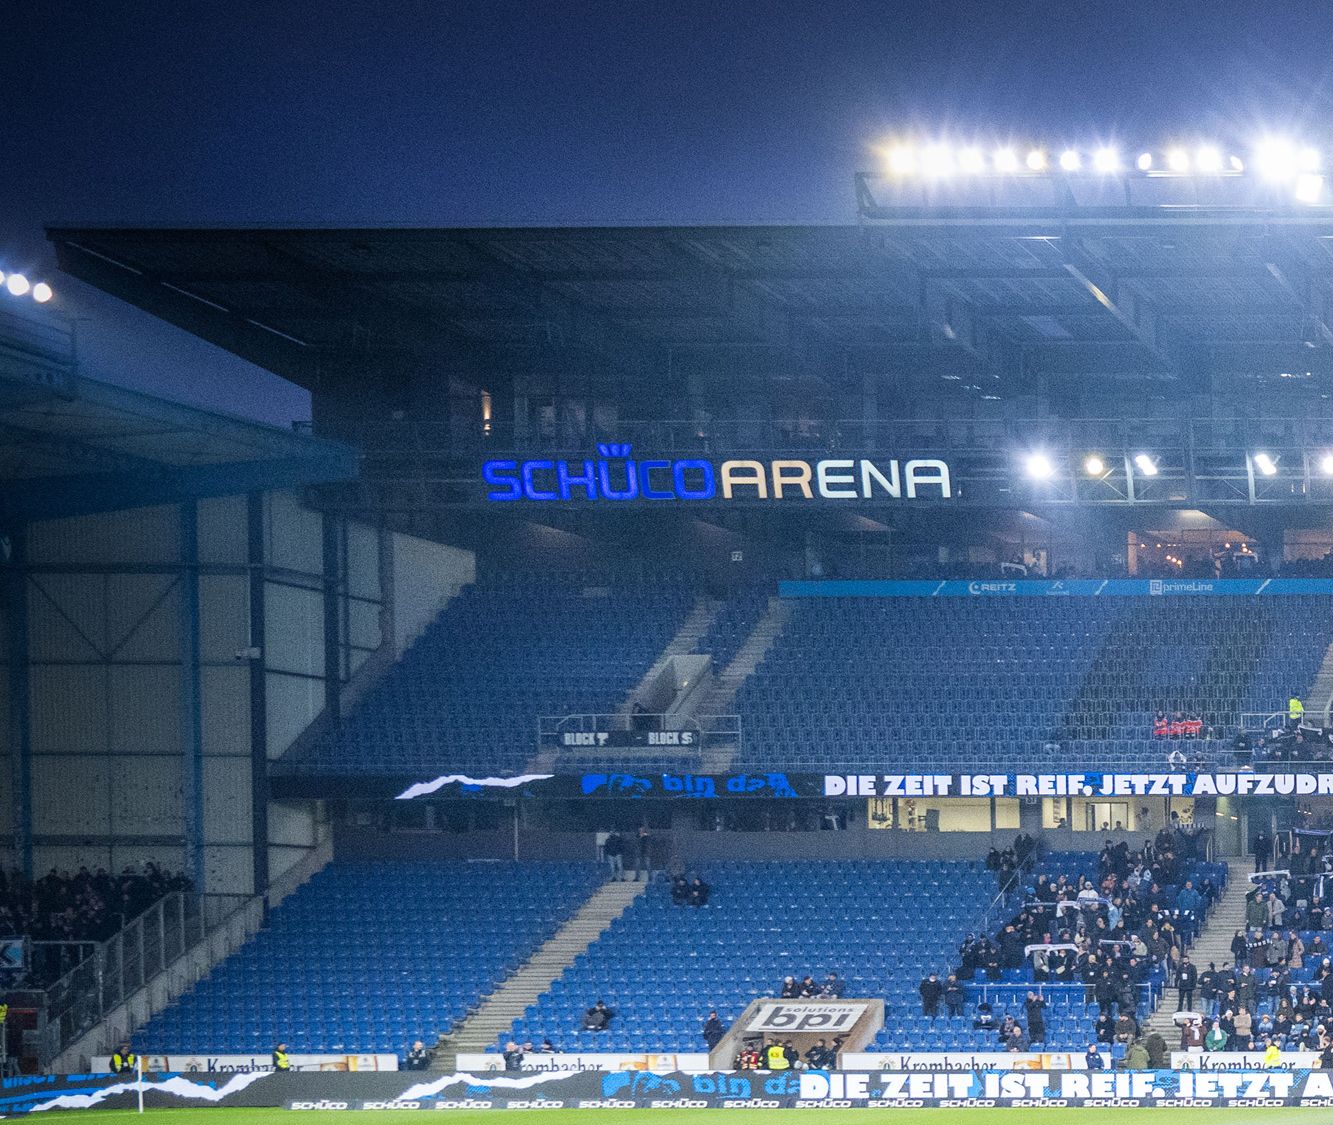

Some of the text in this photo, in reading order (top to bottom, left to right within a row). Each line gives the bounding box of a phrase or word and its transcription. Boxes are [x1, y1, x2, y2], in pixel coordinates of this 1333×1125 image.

[481, 443, 952, 500] SCHÜCOARENA
[1162, 581, 1213, 593] primeLine
[564, 732, 596, 746] BLOCK
[648, 732, 680, 745] BLOCK
[825, 775, 876, 797] DIE
[883, 775, 953, 797] ZEIT
[961, 774, 1008, 796] IST
[1099, 774, 1187, 796] JETZT
[784, 1006, 854, 1014] solutions
[761, 1006, 851, 1031] bpi
[900, 1055, 997, 1070] Krombacher
[800, 1073, 874, 1100] DIE
[880, 1073, 972, 1099] ZEIT
[979, 1073, 1051, 1099] IST
[1060, 1073, 1165, 1099] REIF.
[1174, 1072, 1297, 1099] JETZT
[290, 1099, 348, 1110] SCHÜCO
[362, 1099, 421, 1110] SCHÜCO
[434, 1098, 493, 1109] SCHÜCO
[506, 1098, 564, 1109] SCHÜCO
[578, 1098, 636, 1109] SCHÜCO
[650, 1098, 708, 1109] SCHÜCO
[723, 1098, 780, 1109] SCHÜCO
[795, 1097, 852, 1108] SCHÜCO
[867, 1097, 924, 1108] SCHÜCO
[939, 1097, 996, 1108] SCHÜCO
[1011, 1097, 1068, 1108] SCHÜCO
[1083, 1097, 1140, 1108] SCHÜCO
[1155, 1097, 1213, 1108] SCHÜCO
[1228, 1097, 1285, 1108] SCHÜCO
